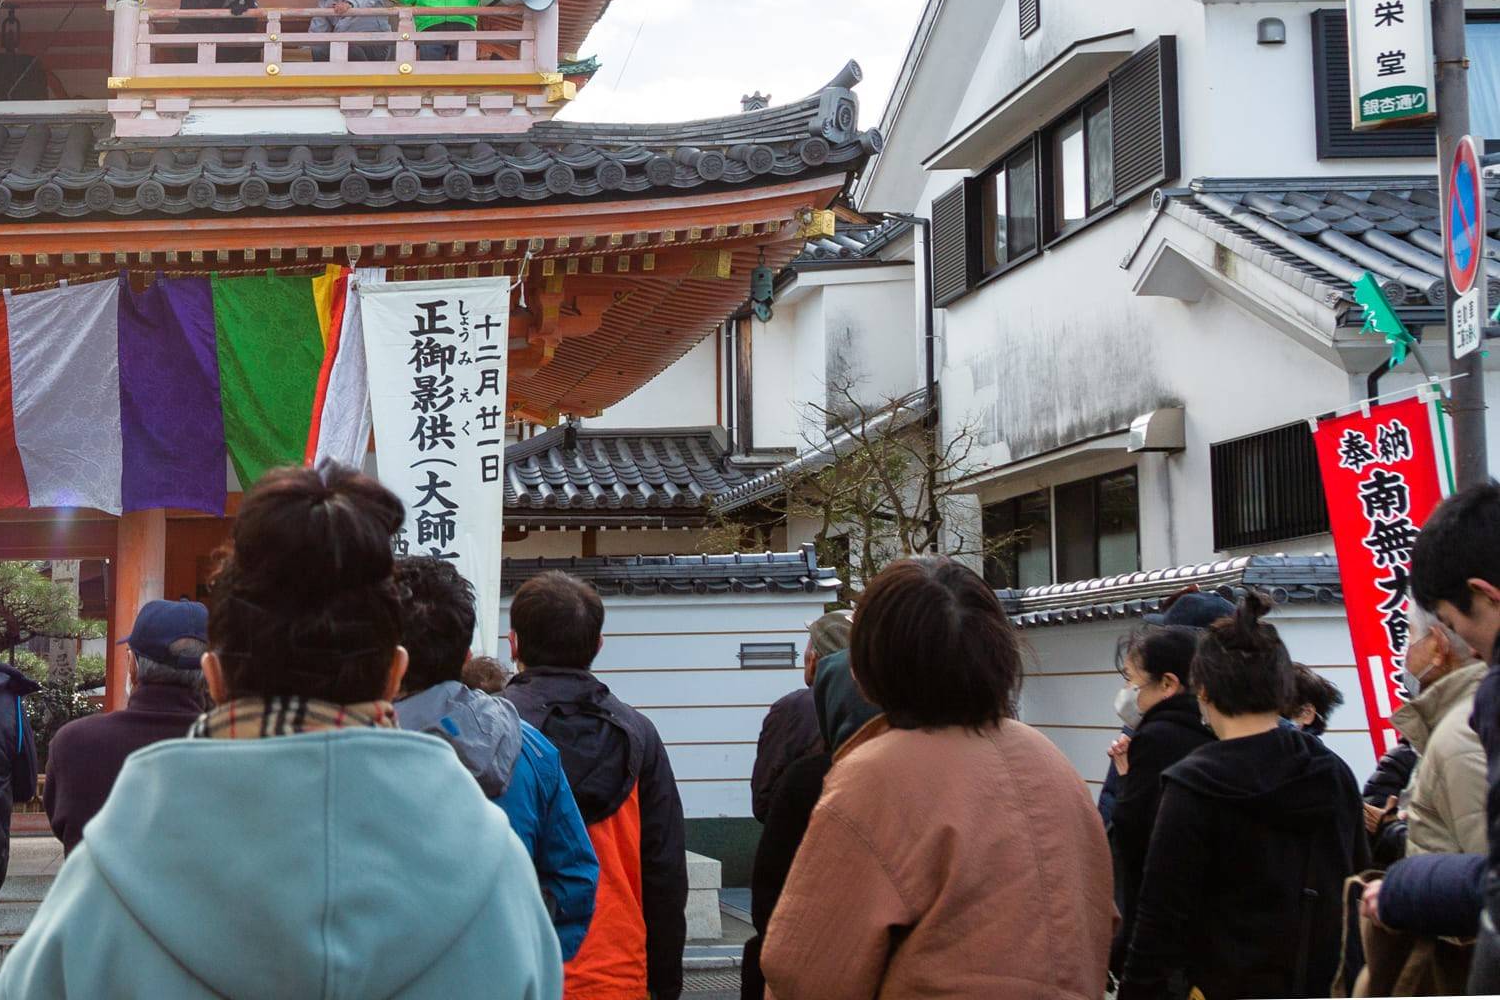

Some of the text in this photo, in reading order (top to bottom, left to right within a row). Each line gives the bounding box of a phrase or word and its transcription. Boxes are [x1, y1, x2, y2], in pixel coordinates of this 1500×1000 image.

[1363, 92, 1426, 116] 銀杏通り
[407, 299, 461, 561] 正御影供（大師
[473, 314, 501, 483] 十二月廿一日
[1340, 420, 1411, 471] 奉納
